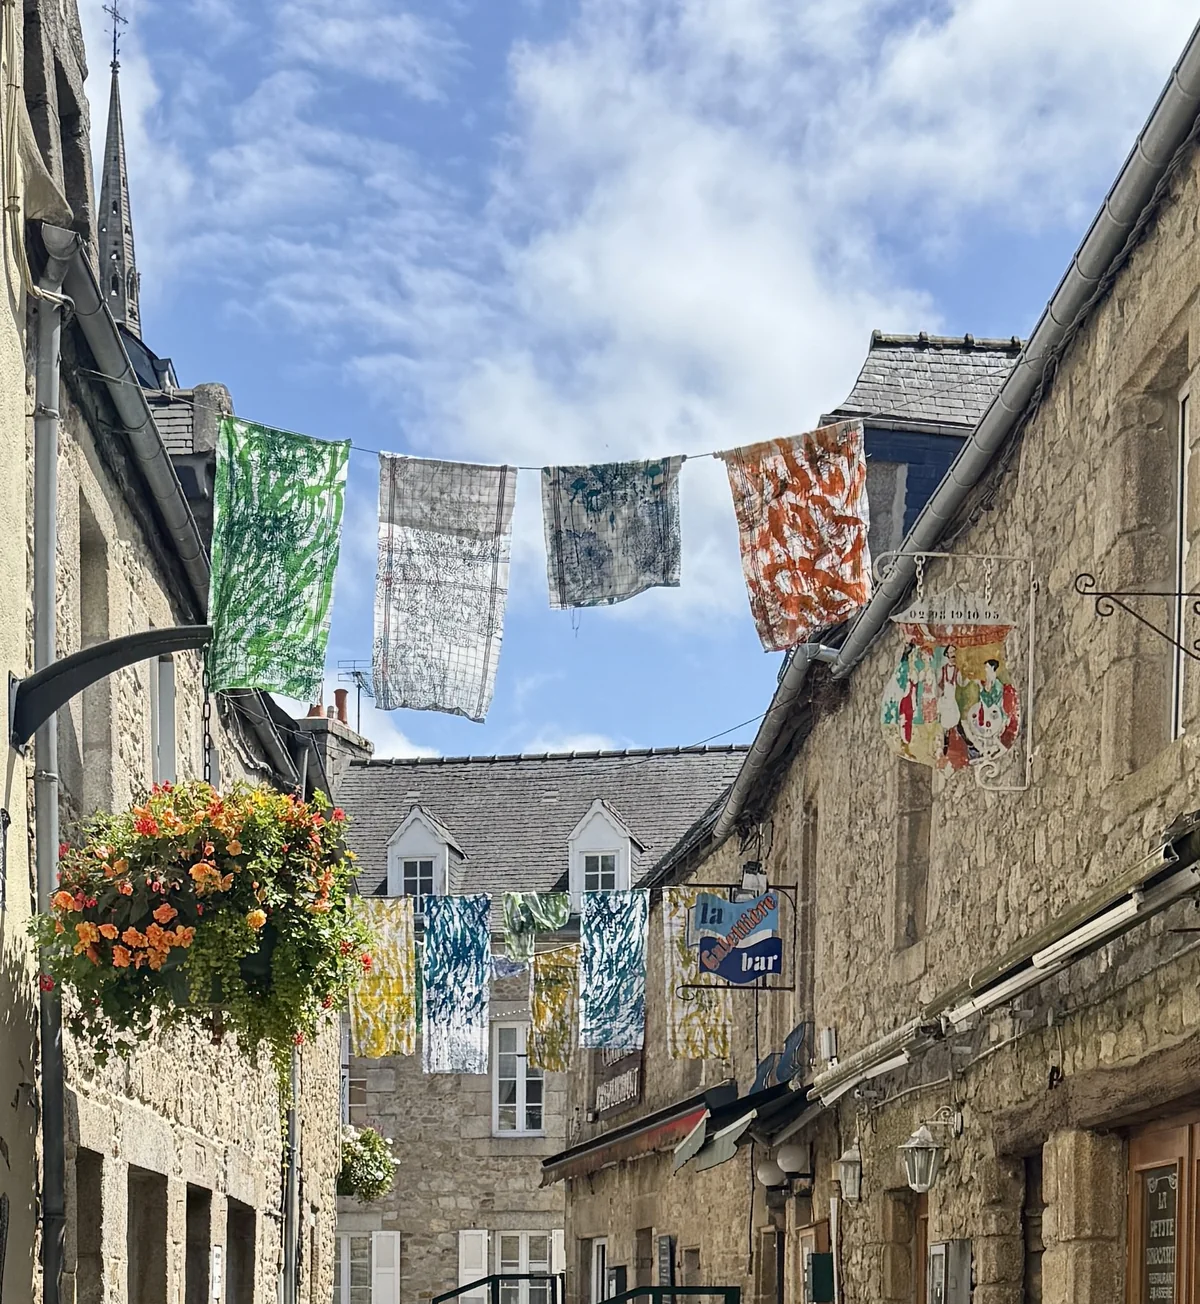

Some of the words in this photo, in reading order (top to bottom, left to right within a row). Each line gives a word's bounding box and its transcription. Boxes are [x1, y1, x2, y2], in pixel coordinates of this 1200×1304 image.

[909, 610, 925, 619] 02
[984, 611, 999, 620] 95
[700, 902, 723, 925] la
[741, 952, 779, 972] bar
[1150, 1218, 1175, 1238] PETITE
